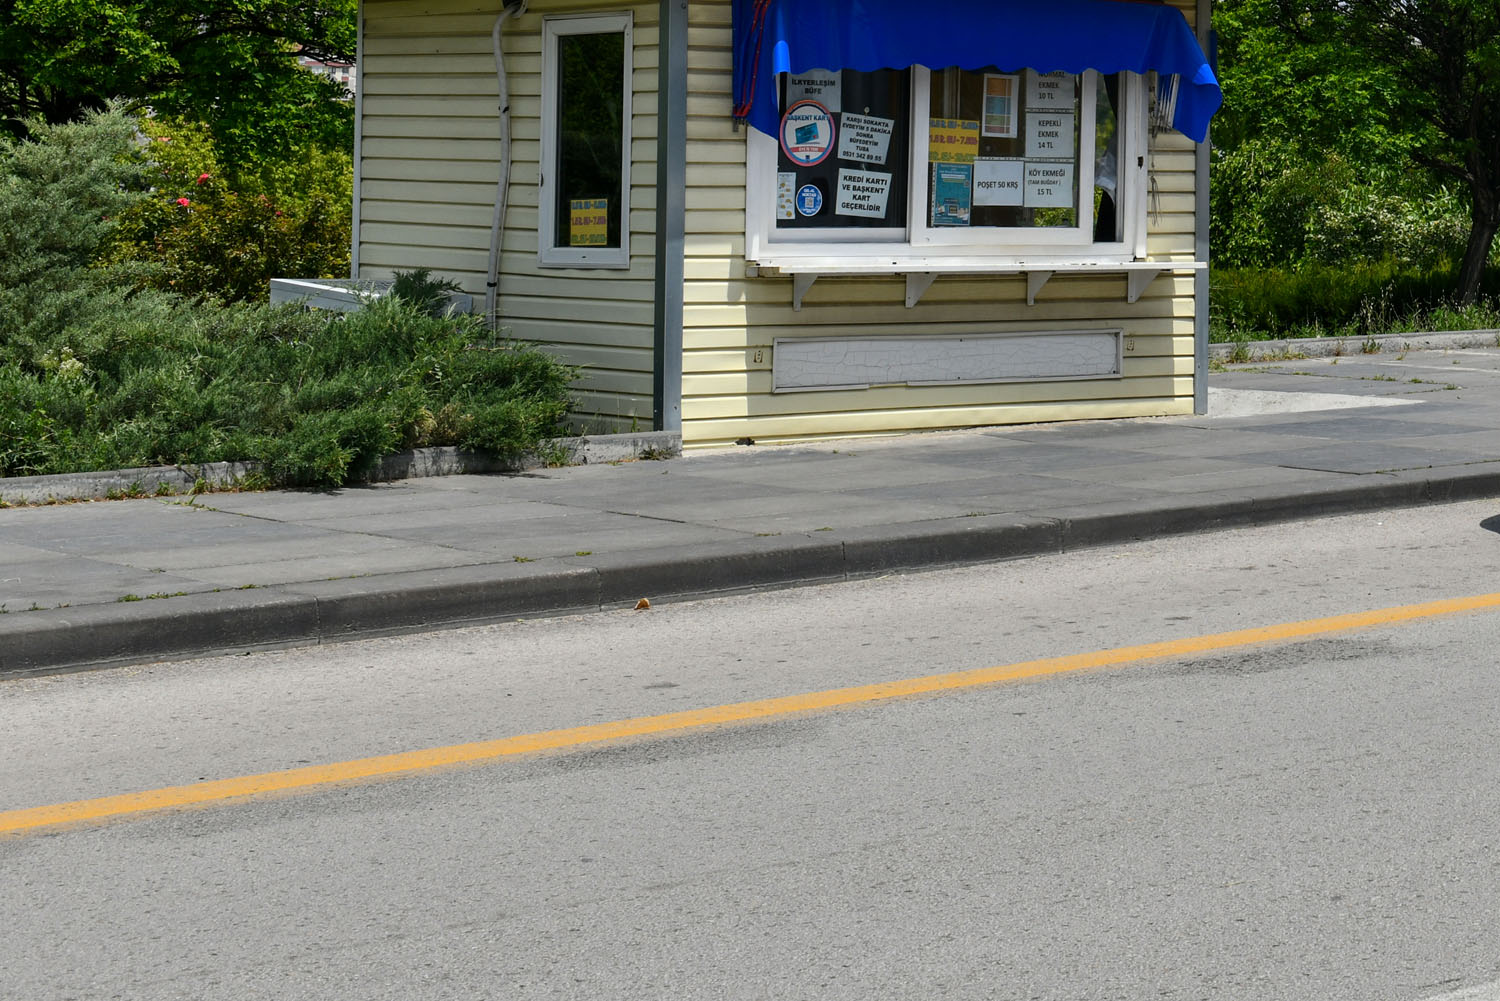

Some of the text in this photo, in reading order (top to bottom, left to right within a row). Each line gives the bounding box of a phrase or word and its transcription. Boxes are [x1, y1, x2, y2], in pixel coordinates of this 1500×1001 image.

[1038, 81, 1060, 89] EKMEK
[804, 86, 822, 95] BÜFE
[1038, 92, 1054, 100] 10 TL
[787, 114, 813, 122] BAŞKENT
[1038, 119, 1062, 127] KEPEKLİ
[1037, 130, 1059, 138] EKMEK
[1028, 168, 1066, 177] KÖY EKMEĞİ
[843, 174, 888, 186] KREDİ KARTI
[977, 181, 1018, 190] POŞET 50 KRŞ
[852, 185, 885, 195] BAŞKENT
[1037, 188, 1053, 196] 15 TL
[852, 194, 871, 202] KART
[841, 201, 881, 212] GEÇERLİDİR
